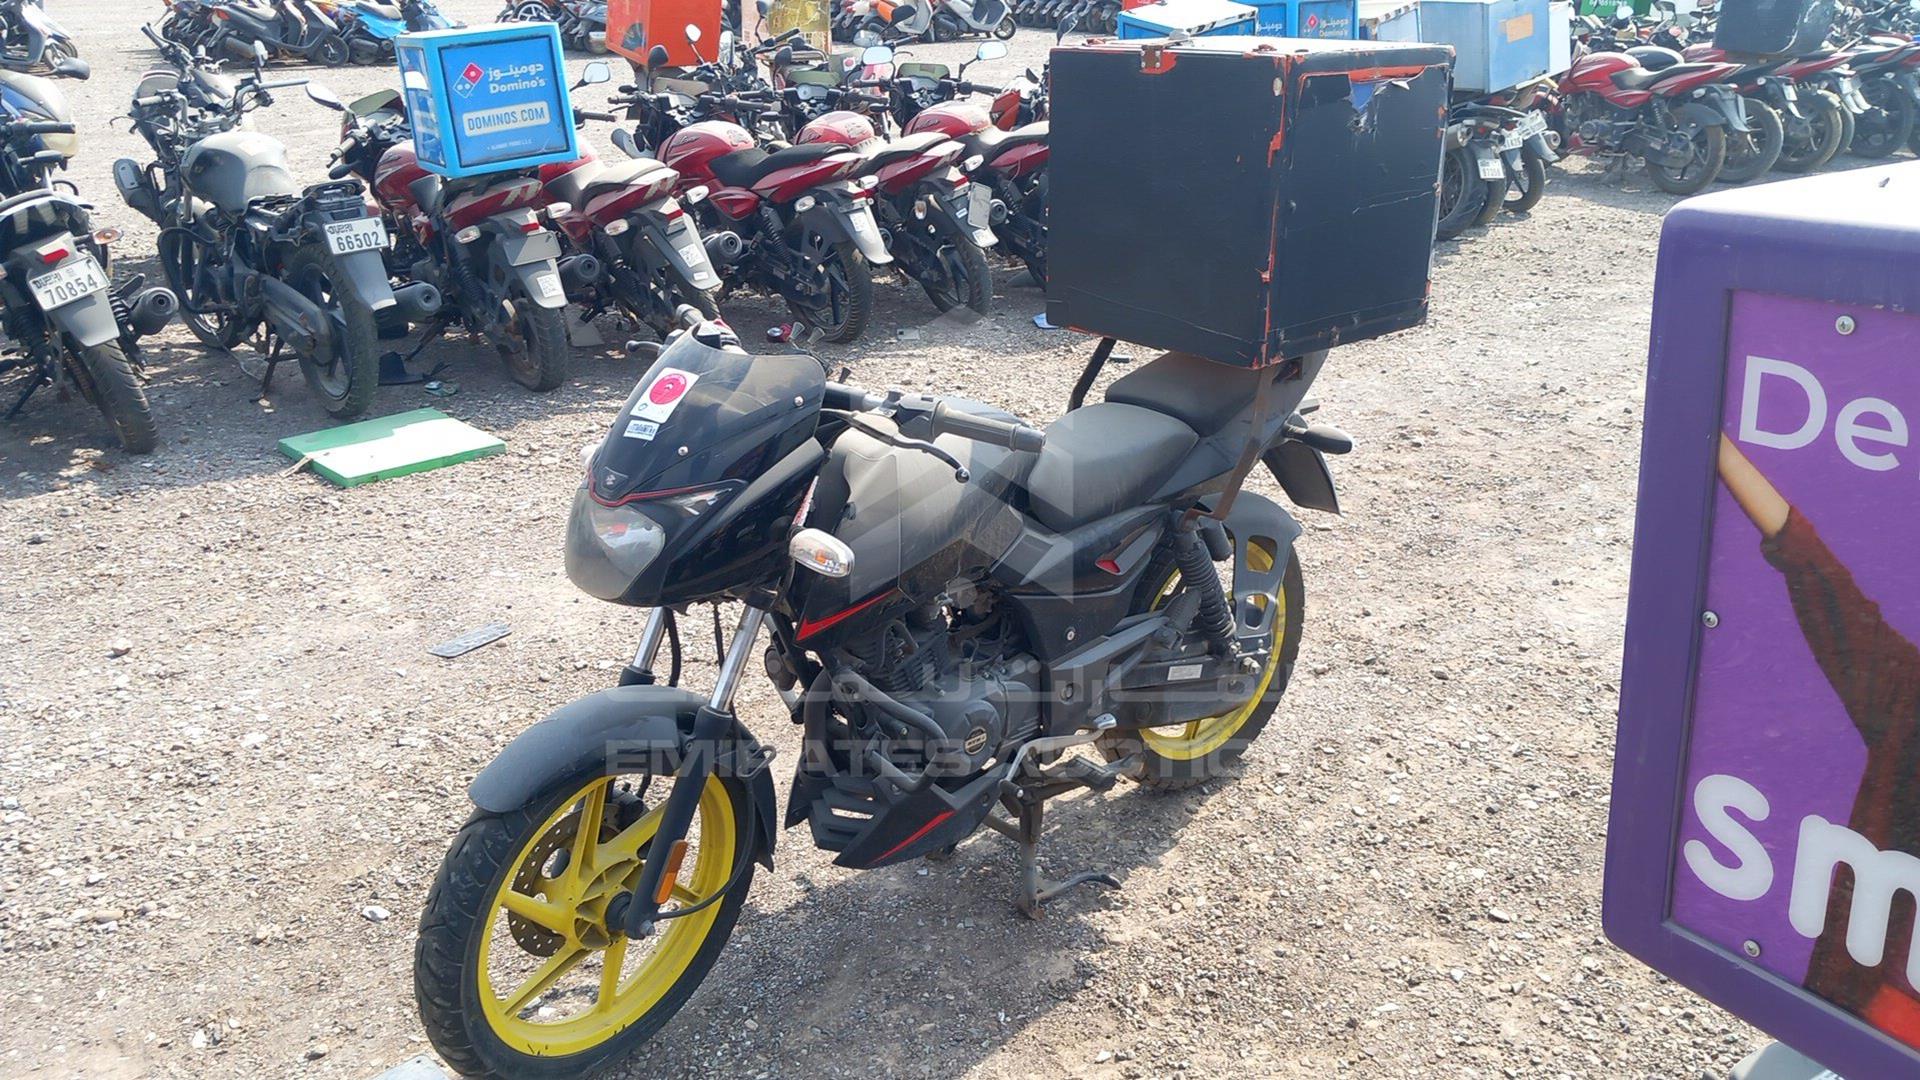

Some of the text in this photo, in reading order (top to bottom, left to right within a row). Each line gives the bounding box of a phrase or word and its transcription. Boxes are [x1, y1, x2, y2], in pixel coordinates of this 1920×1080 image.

[488, 62, 545, 81] دومينوز
[489, 77, 546, 94] Domino's
[467, 107, 545, 131] DOMINOS.COM
[336, 231, 381, 251] 66502
[44, 273, 99, 305] 70854
[1738, 355, 1920, 471] De
